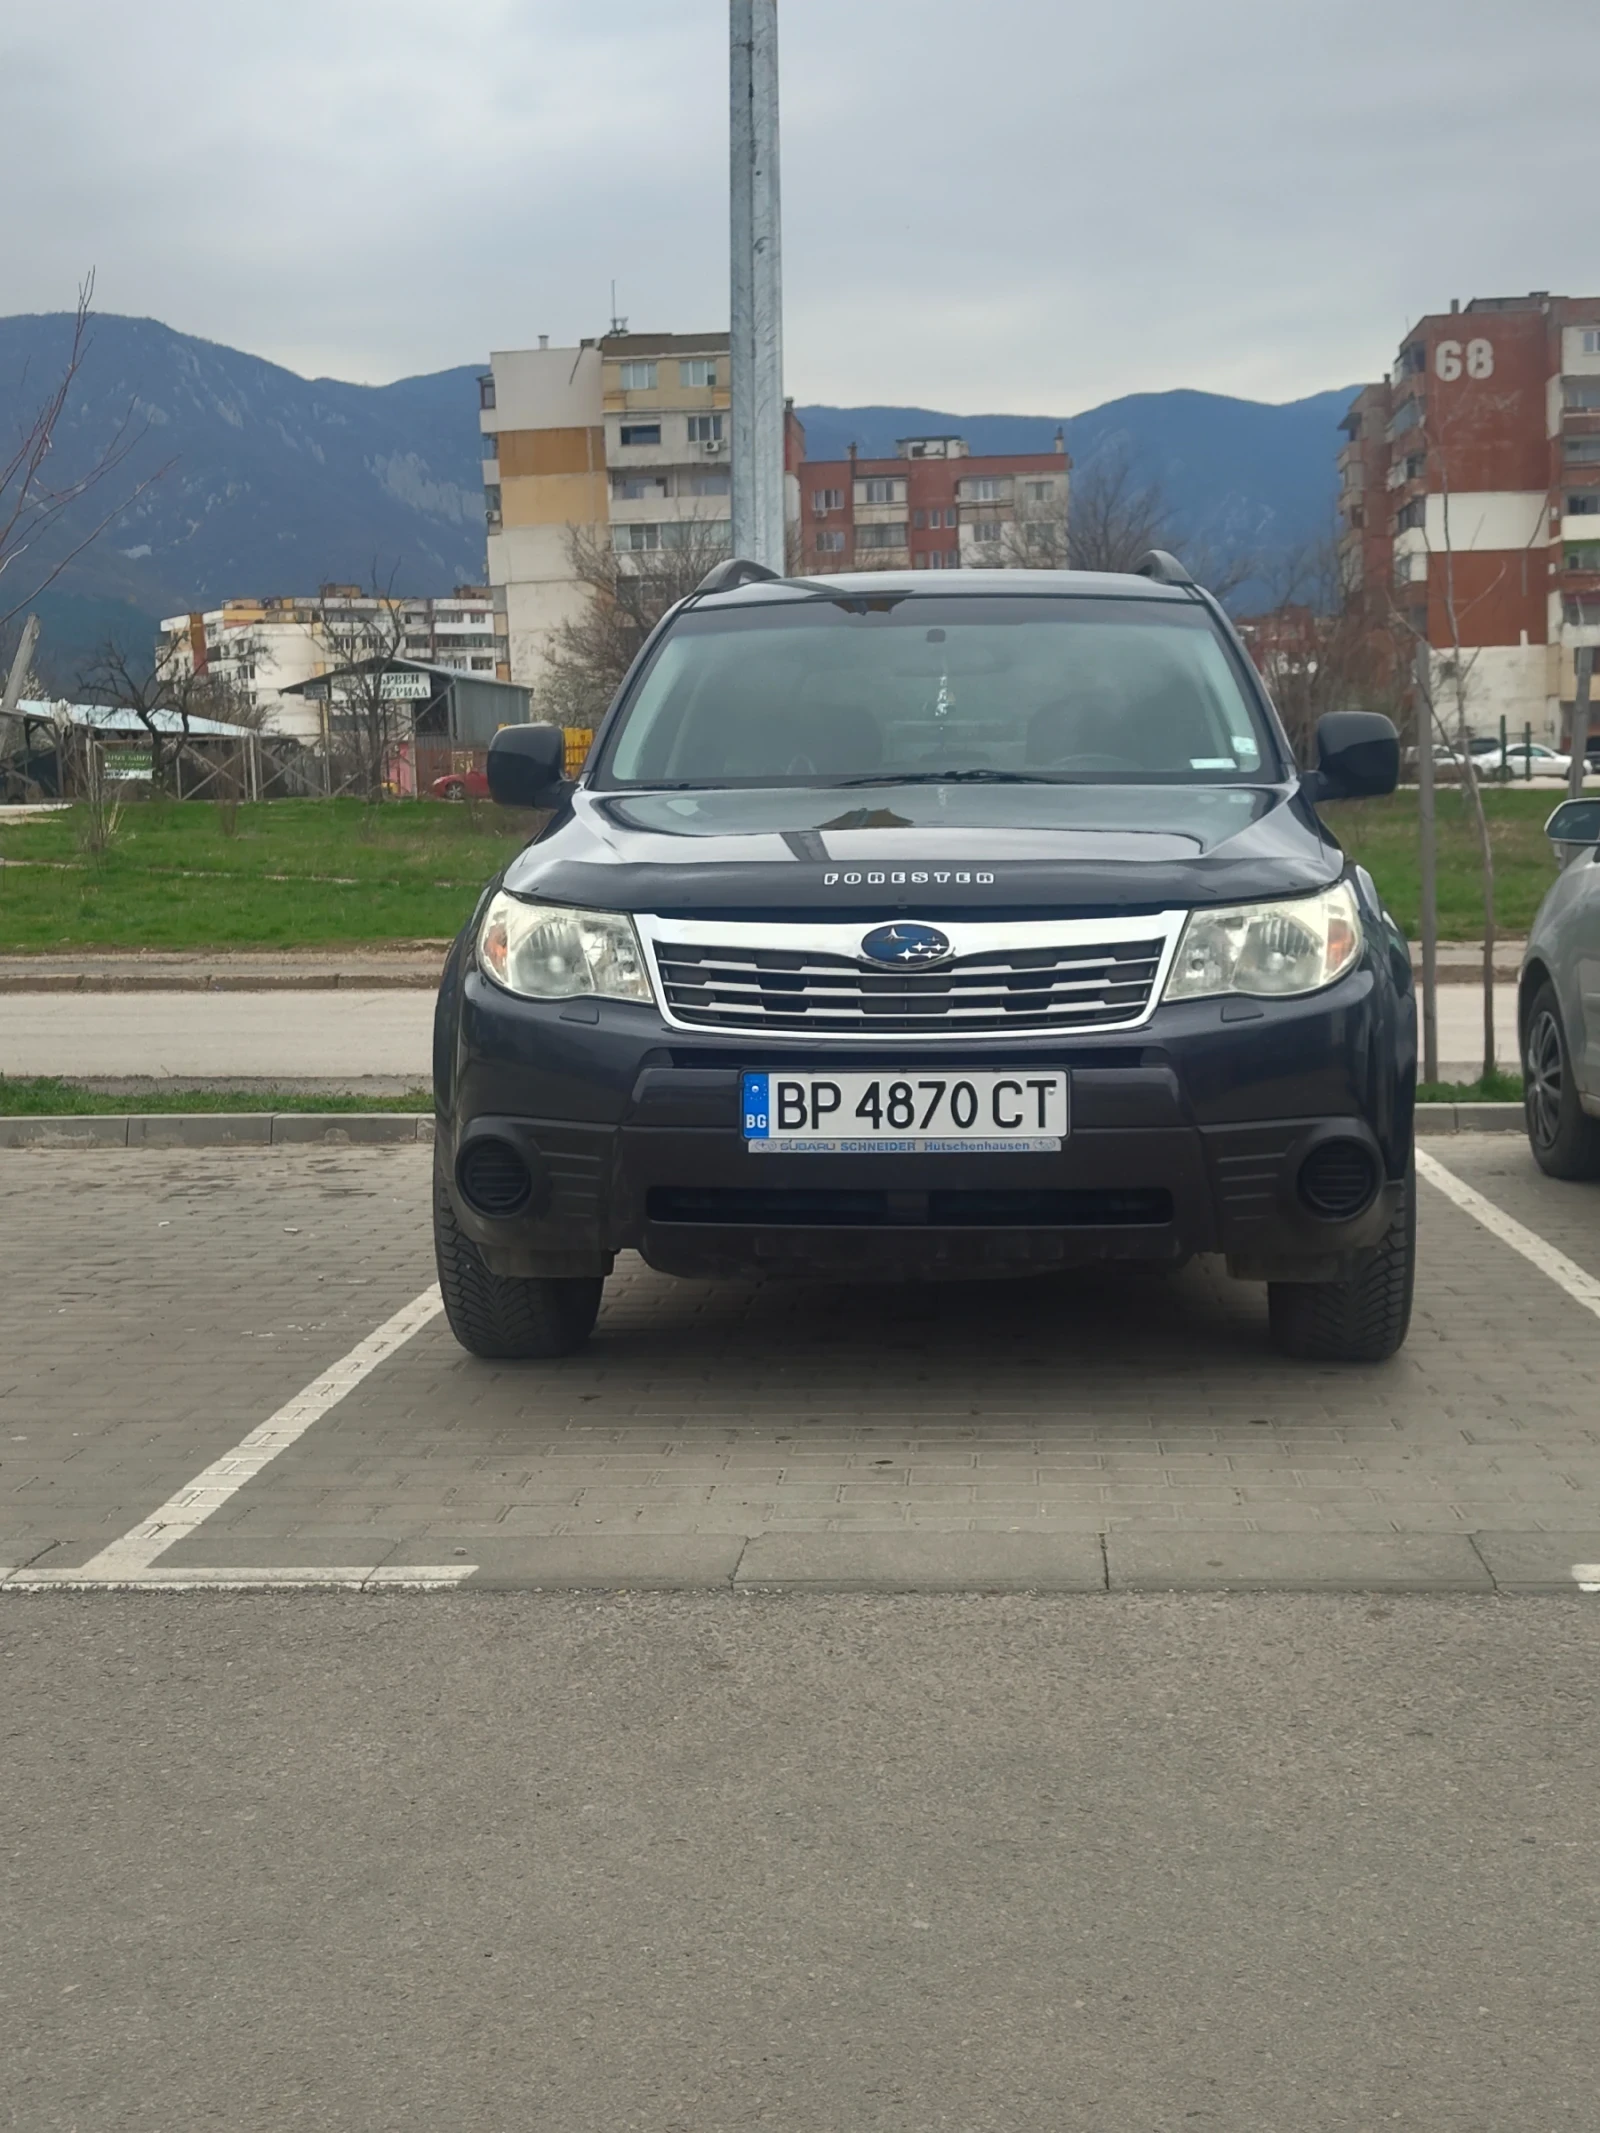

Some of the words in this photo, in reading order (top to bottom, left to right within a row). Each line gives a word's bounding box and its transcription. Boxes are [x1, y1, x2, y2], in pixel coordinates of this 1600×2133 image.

[1435, 338, 1494, 382] 68
[824, 871, 995, 885] FORESTER
[776, 1080, 841, 1130] BP
[855, 1080, 978, 1130] 4870
[992, 1079, 1057, 1129] CT
[745, 1114, 767, 1129] BG
[780, 1141, 836, 1151] SUBARU
[840, 1141, 916, 1151] SCHNEIDER
